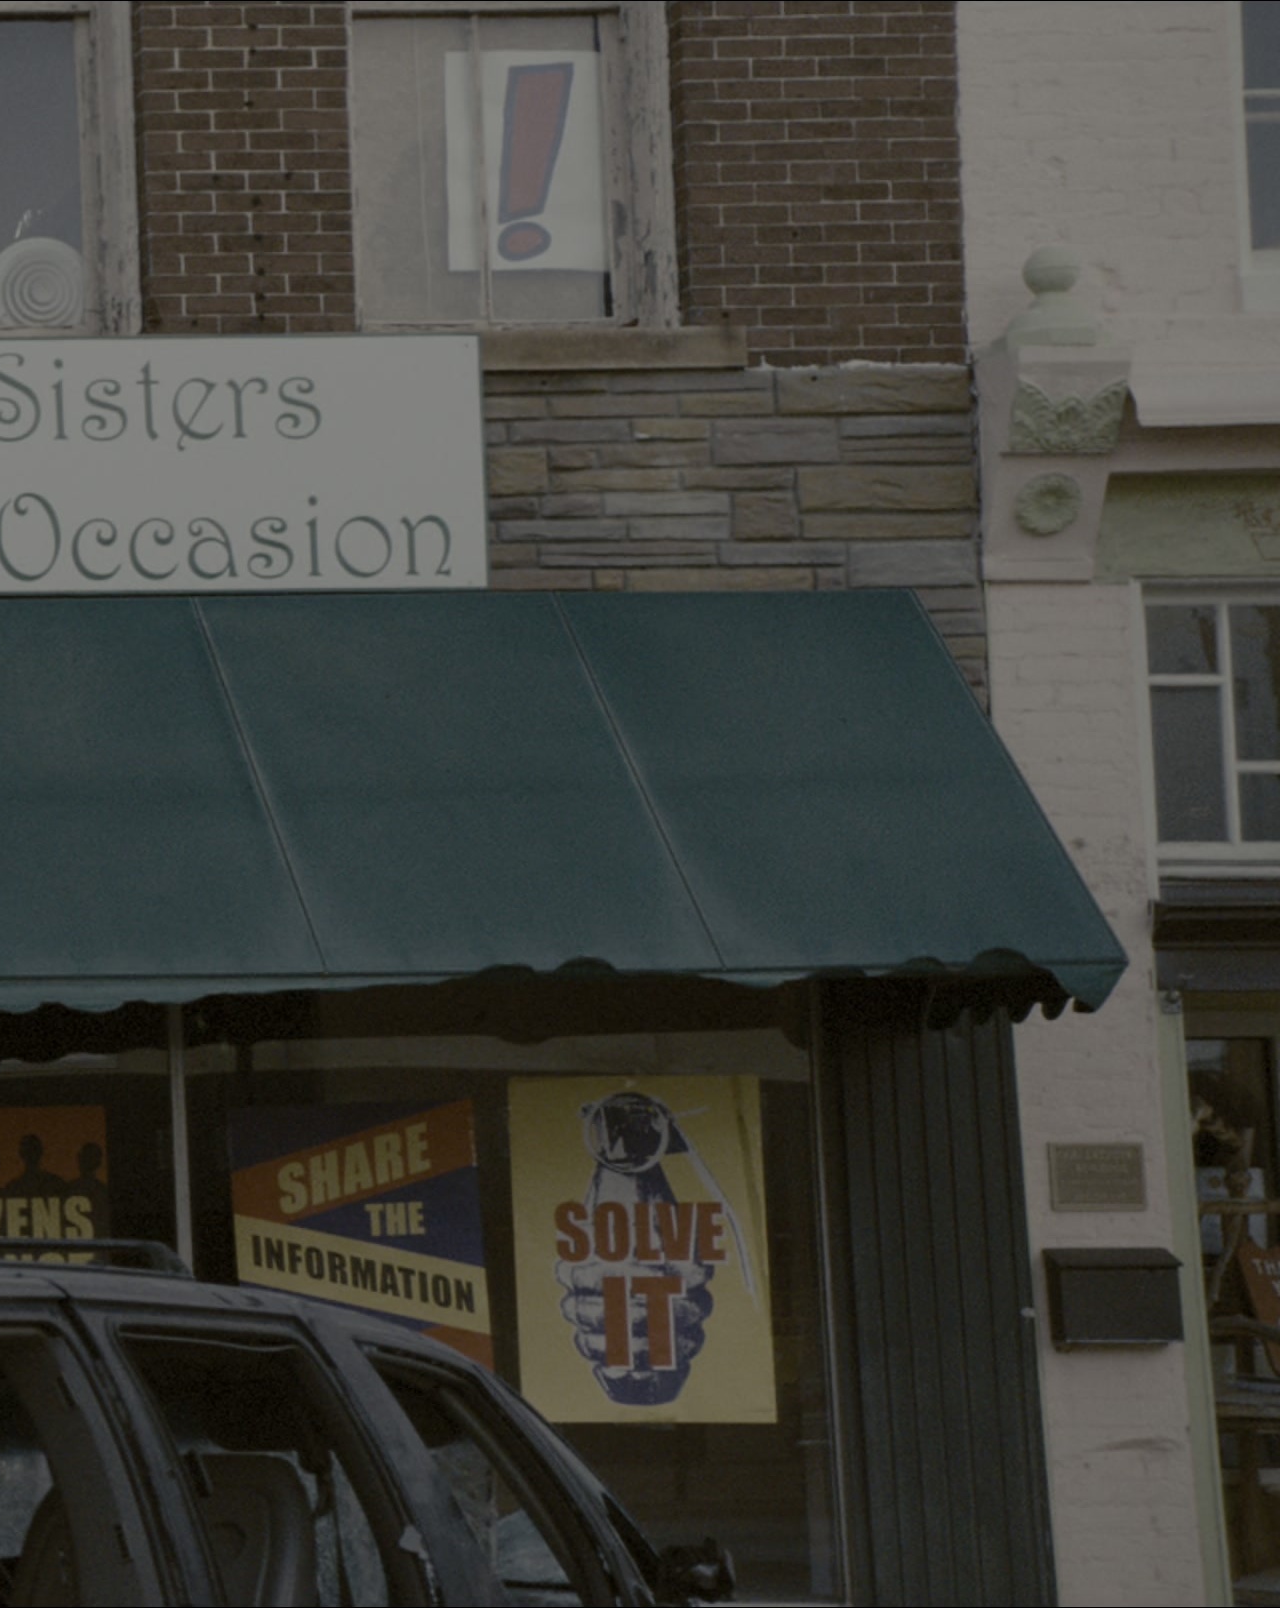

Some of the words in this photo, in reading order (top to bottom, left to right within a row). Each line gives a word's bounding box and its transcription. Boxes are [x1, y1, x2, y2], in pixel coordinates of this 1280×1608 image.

[277, 1121, 431, 1214] SHARE
[365, 1201, 427, 1237] THE
[553, 1200, 728, 1263] SOLVE
[251, 1235, 476, 1313] INFORMATION
[602, 1274, 686, 1370] IT
